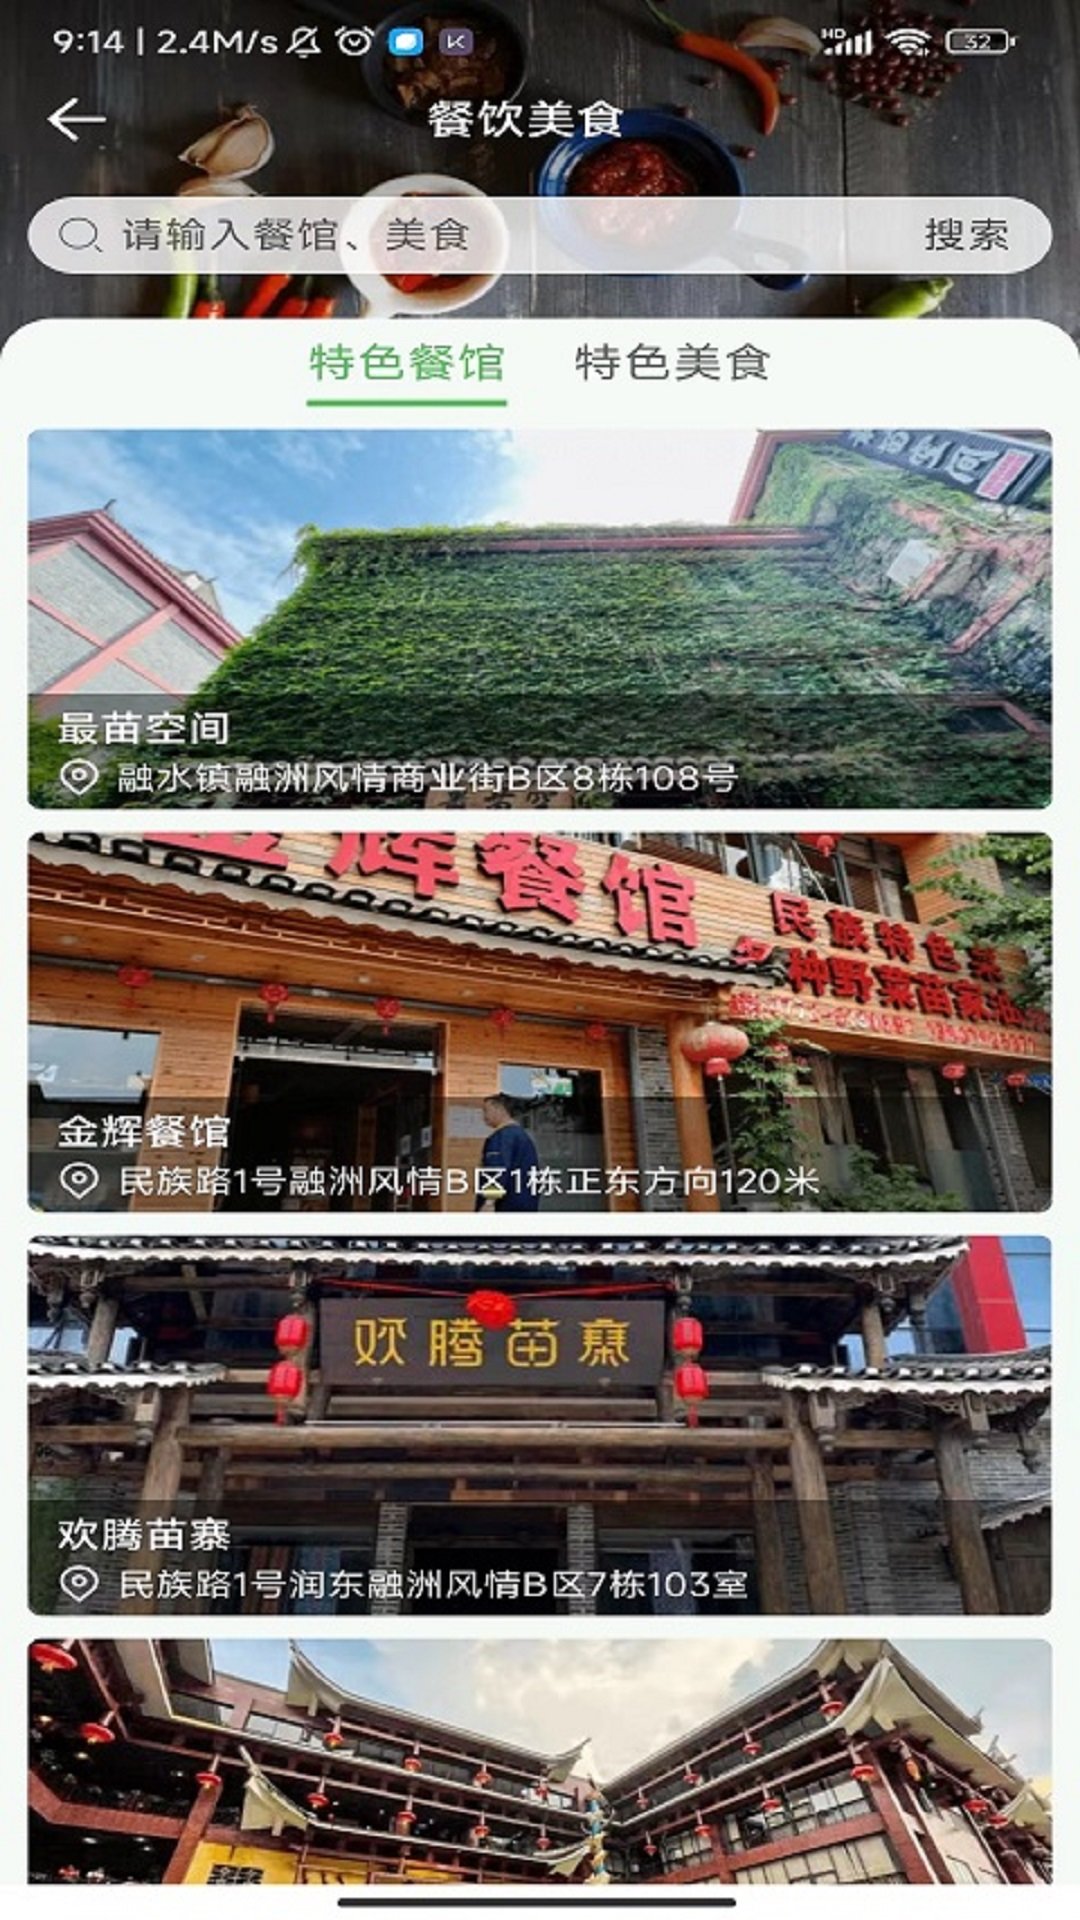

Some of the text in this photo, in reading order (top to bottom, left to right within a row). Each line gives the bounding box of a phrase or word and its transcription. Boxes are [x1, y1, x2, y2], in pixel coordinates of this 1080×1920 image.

[53, 30, 125, 54] 9:14
[157, 30, 279, 55] 2.4M/s
[821, 28, 847, 39] HD
[964, 33, 991, 50] 32
[428, 100, 624, 138] 餐饮美食
[122, 217, 470, 251] 请输入餐馆、美食
[925, 217, 1009, 251] 搜索
[309, 342, 505, 382] 特色餐馆
[575, 342, 771, 382] 特色美食
[58, 711, 230, 745] 最苗空间
[117, 762, 739, 793] 融水镇融洲风情商业街B区8栋108号
[58, 1114, 231, 1149] 金辉餐馆
[119, 1165, 820, 1197] 民族路1号融洲风情B区1栋正东方向120米
[58, 1517, 231, 1551] 欢腾苗寨
[119, 1569, 749, 1600] 民族路1号润东融洲风情B区7栋103室
